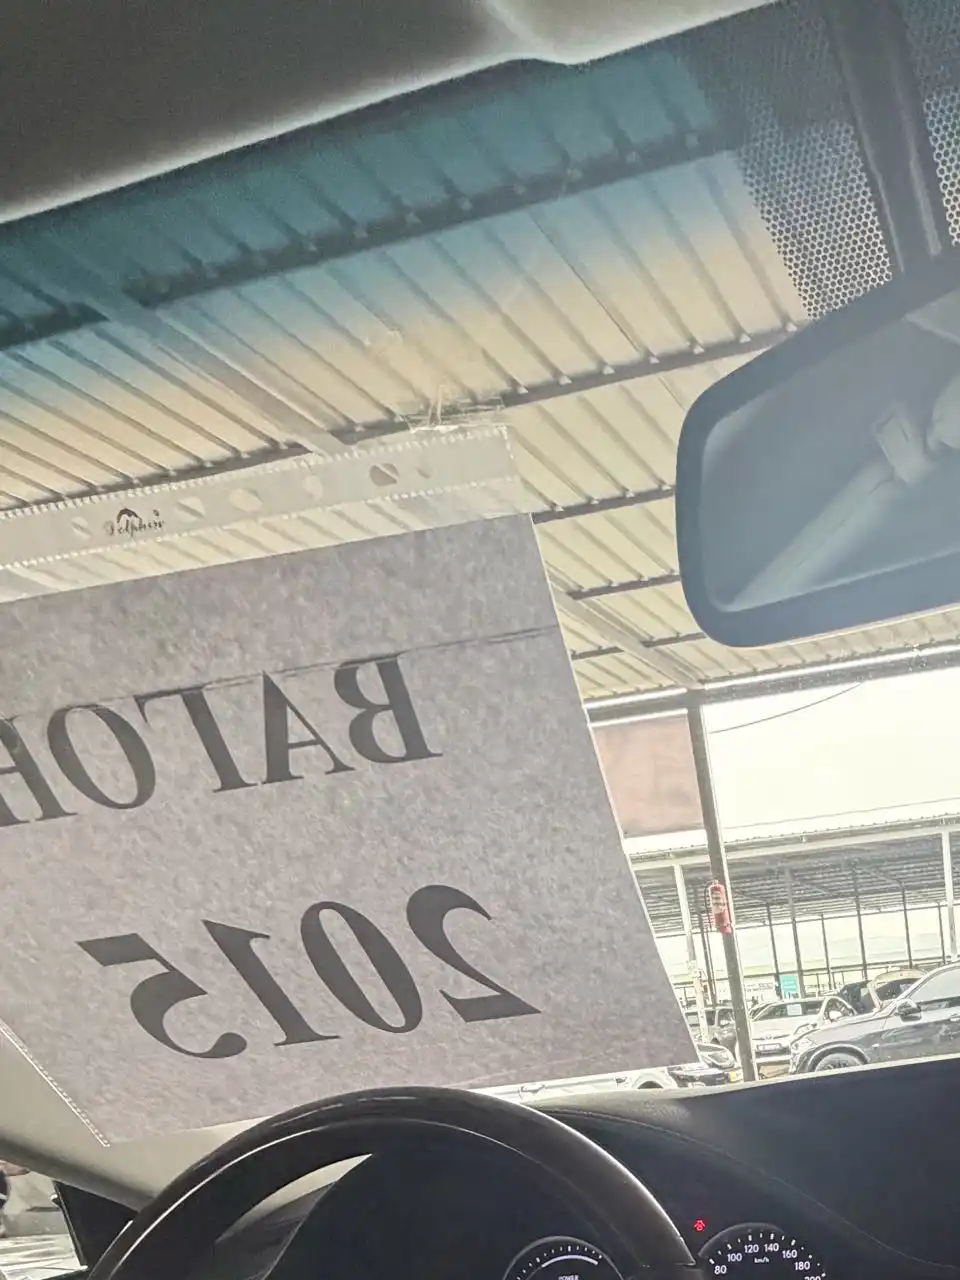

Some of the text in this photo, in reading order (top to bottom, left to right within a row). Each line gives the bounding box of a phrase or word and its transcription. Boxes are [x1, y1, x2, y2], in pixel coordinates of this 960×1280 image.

[744, 1244, 760, 1254] 120
[764, 1242, 780, 1252] 140
[727, 1252, 743, 1262] 100
[782, 1249, 798, 1259] 160
[714, 1264, 727, 1275] 80
[794, 1261, 811, 1271] 180
